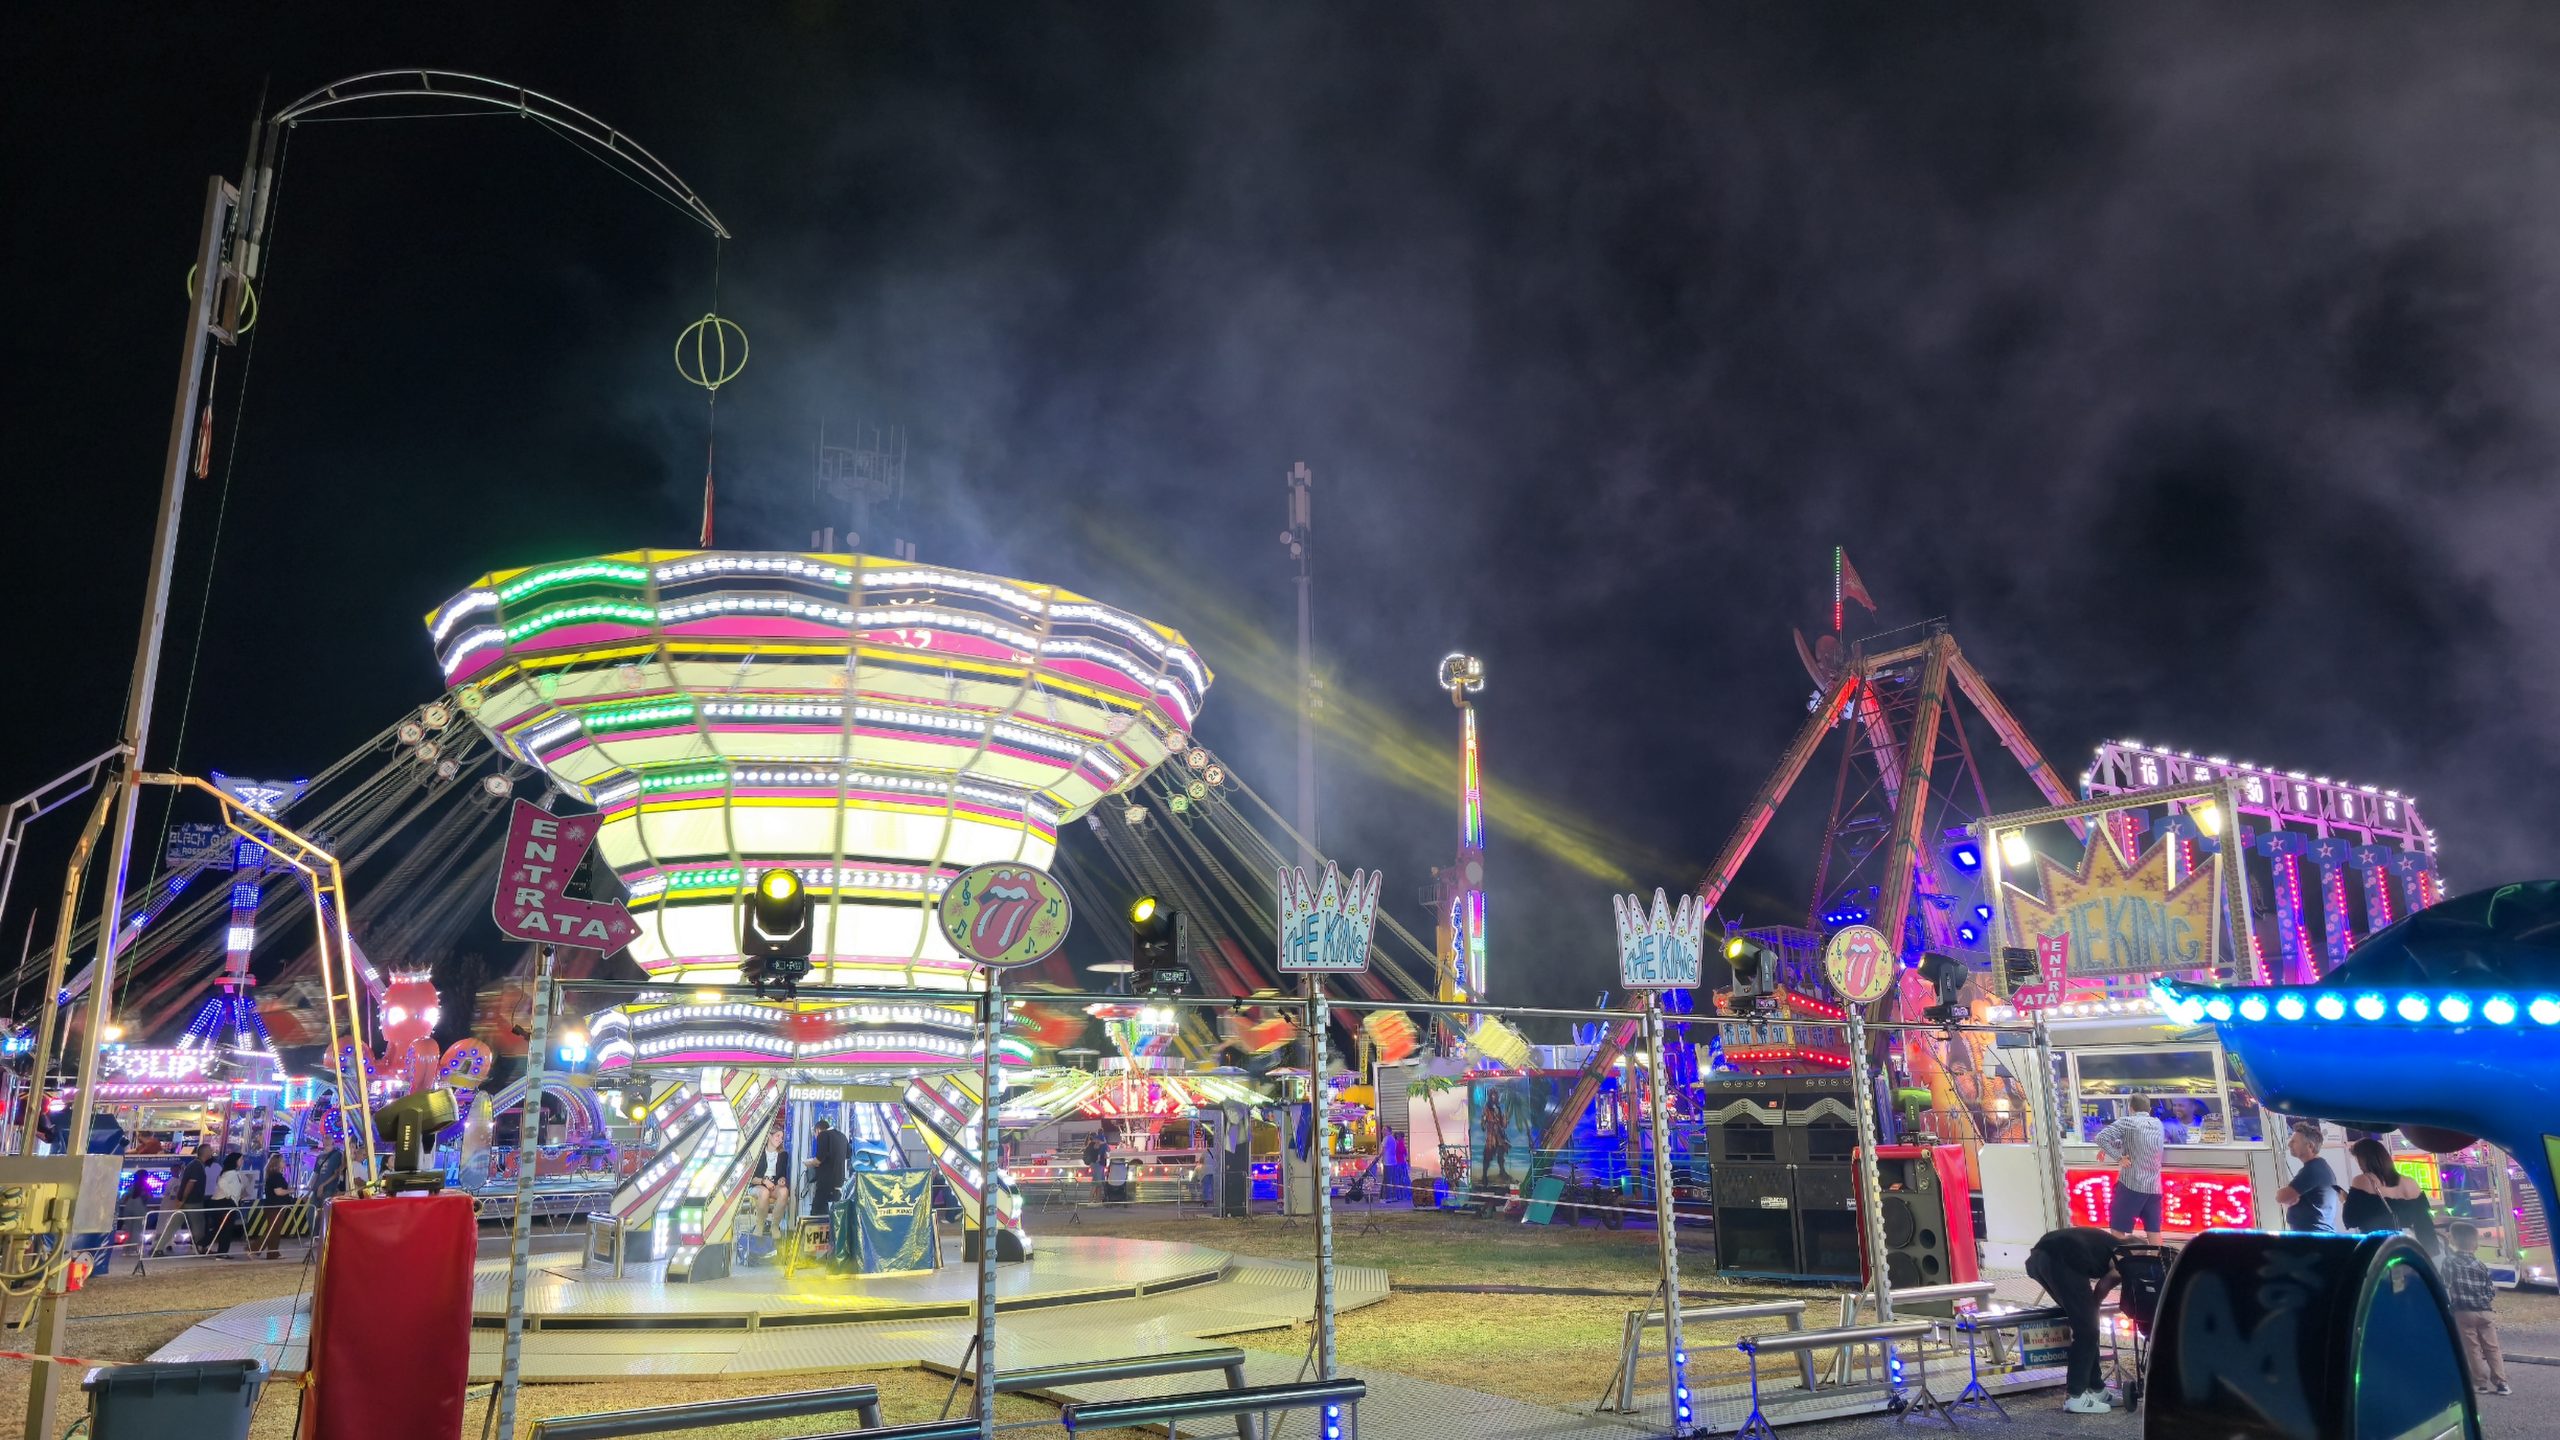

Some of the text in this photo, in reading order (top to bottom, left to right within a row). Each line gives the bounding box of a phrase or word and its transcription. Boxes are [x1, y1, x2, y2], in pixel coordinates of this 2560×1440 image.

[2140, 764, 2159, 786] 16
[2298, 791, 2308, 811] 0
[2344, 800, 2353, 819] 0
[514, 819, 610, 940] ENTRATA
[1283, 911, 1365, 964] THE KING
[2103, 895, 2200, 968] KING
[1625, 932, 1697, 980] THE KING
[2023, 941, 2062, 1006] ENTRATA
[789, 1086, 843, 1101] Inserisci
[2073, 1175, 2252, 1227] TIETS
[2030, 1351, 2069, 1363] facebook
